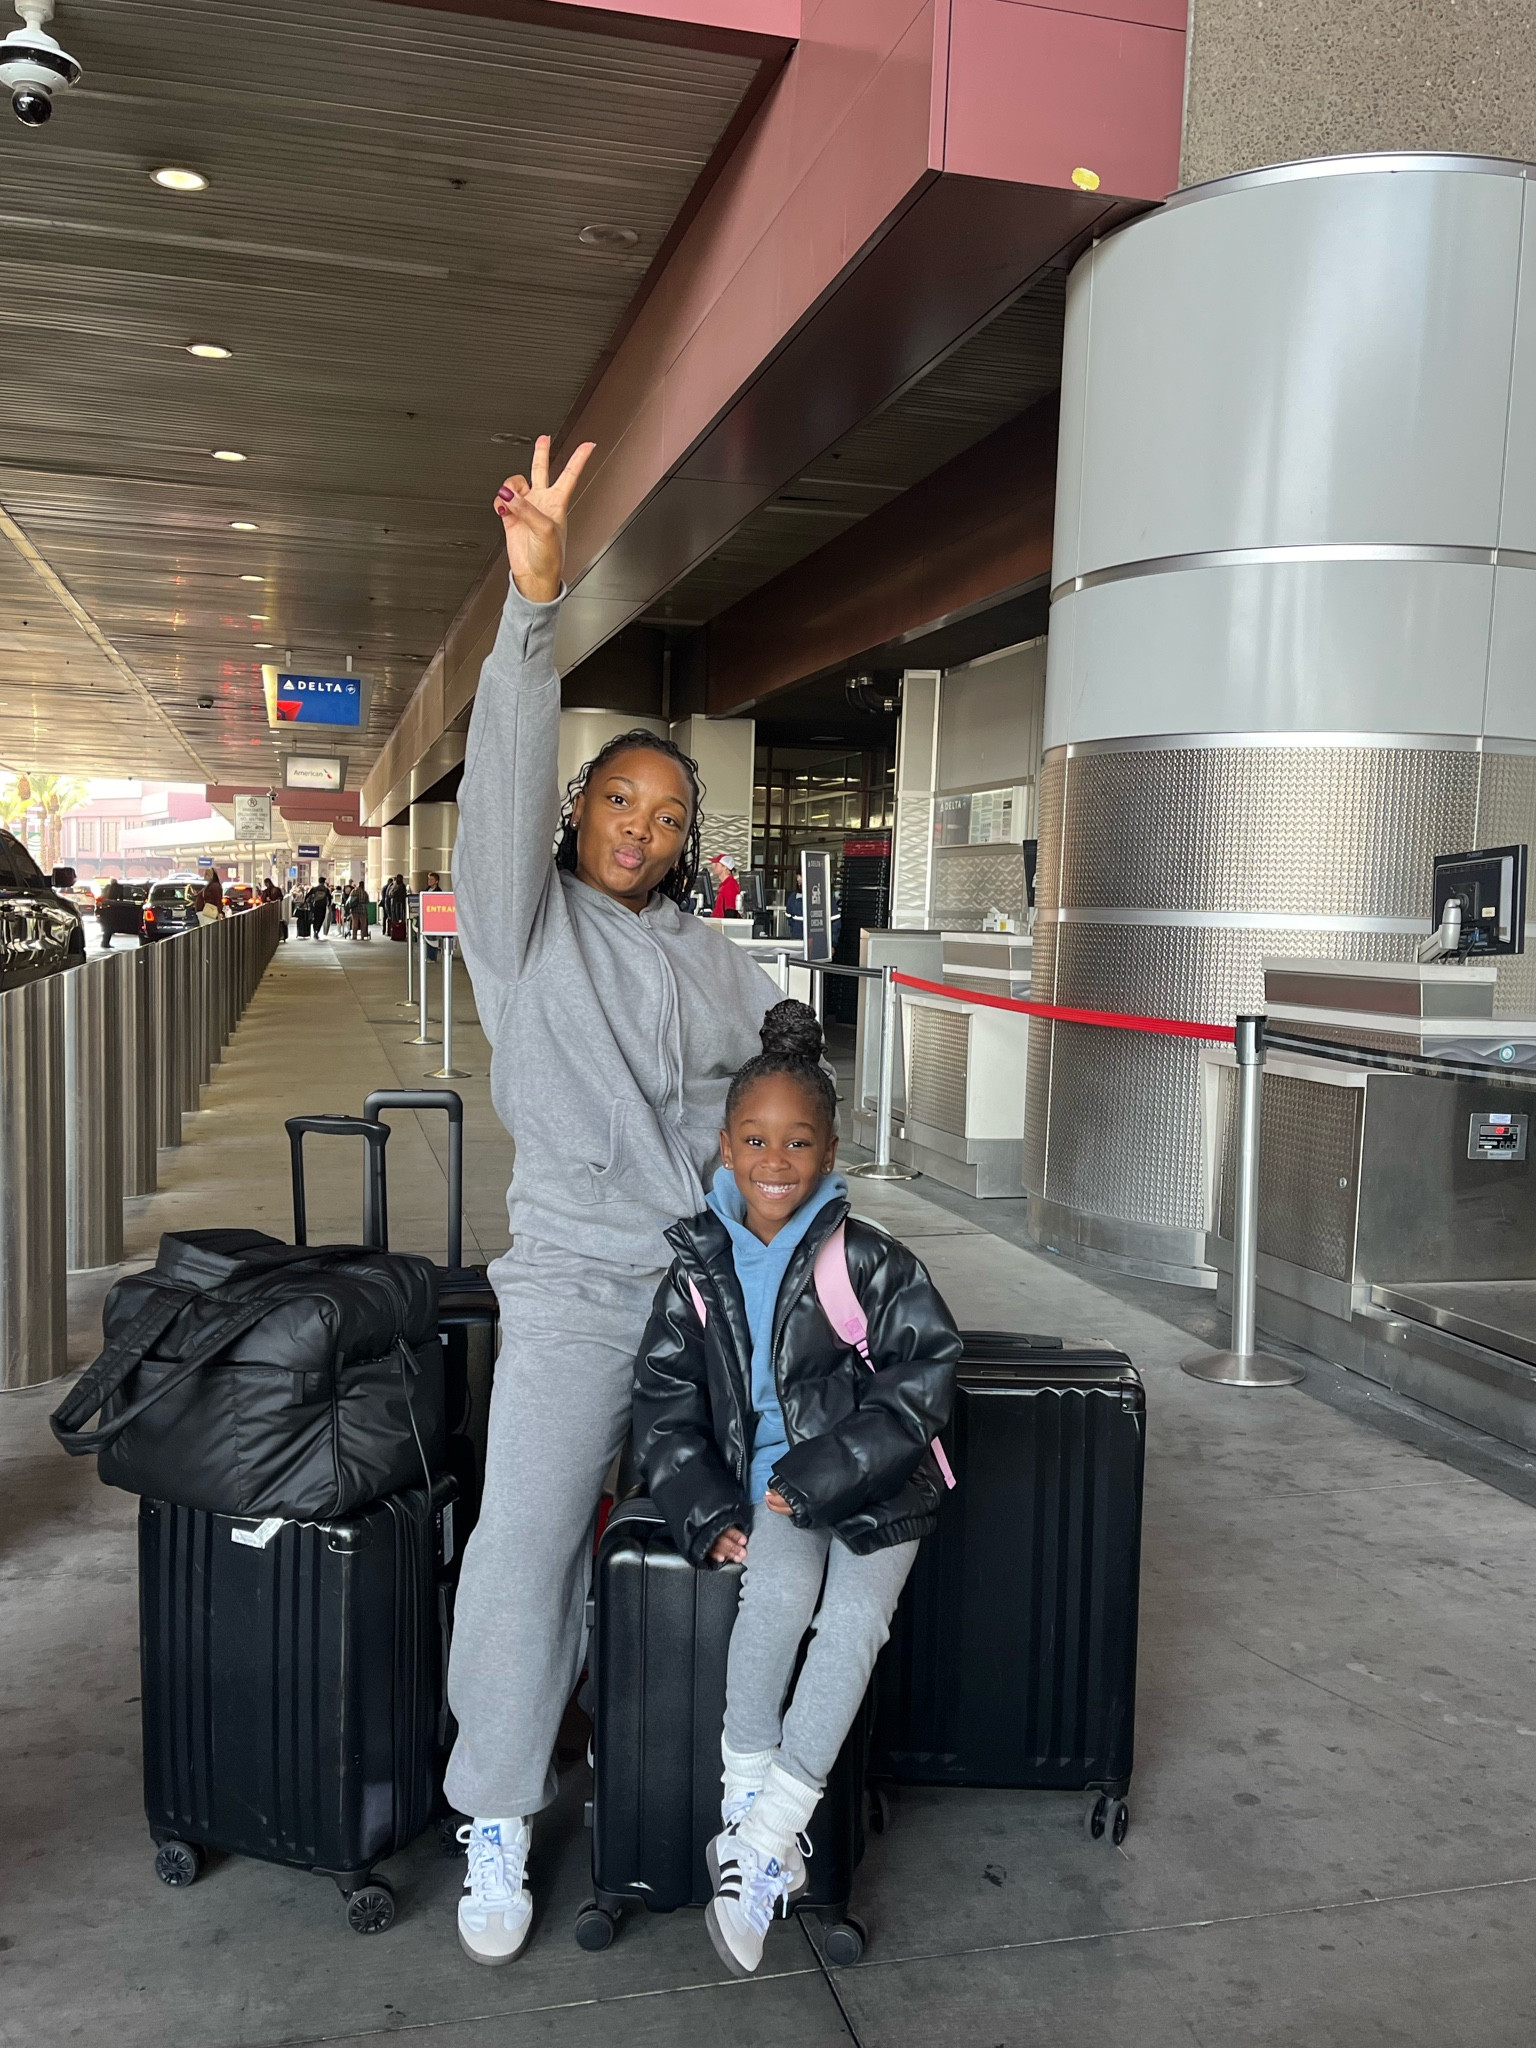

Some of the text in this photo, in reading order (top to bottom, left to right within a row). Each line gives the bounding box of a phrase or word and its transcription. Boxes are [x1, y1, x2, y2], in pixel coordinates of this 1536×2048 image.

[297, 680, 342, 693] DELTA
[294, 769, 323, 777] American
[945, 800, 961, 811] DELTA
